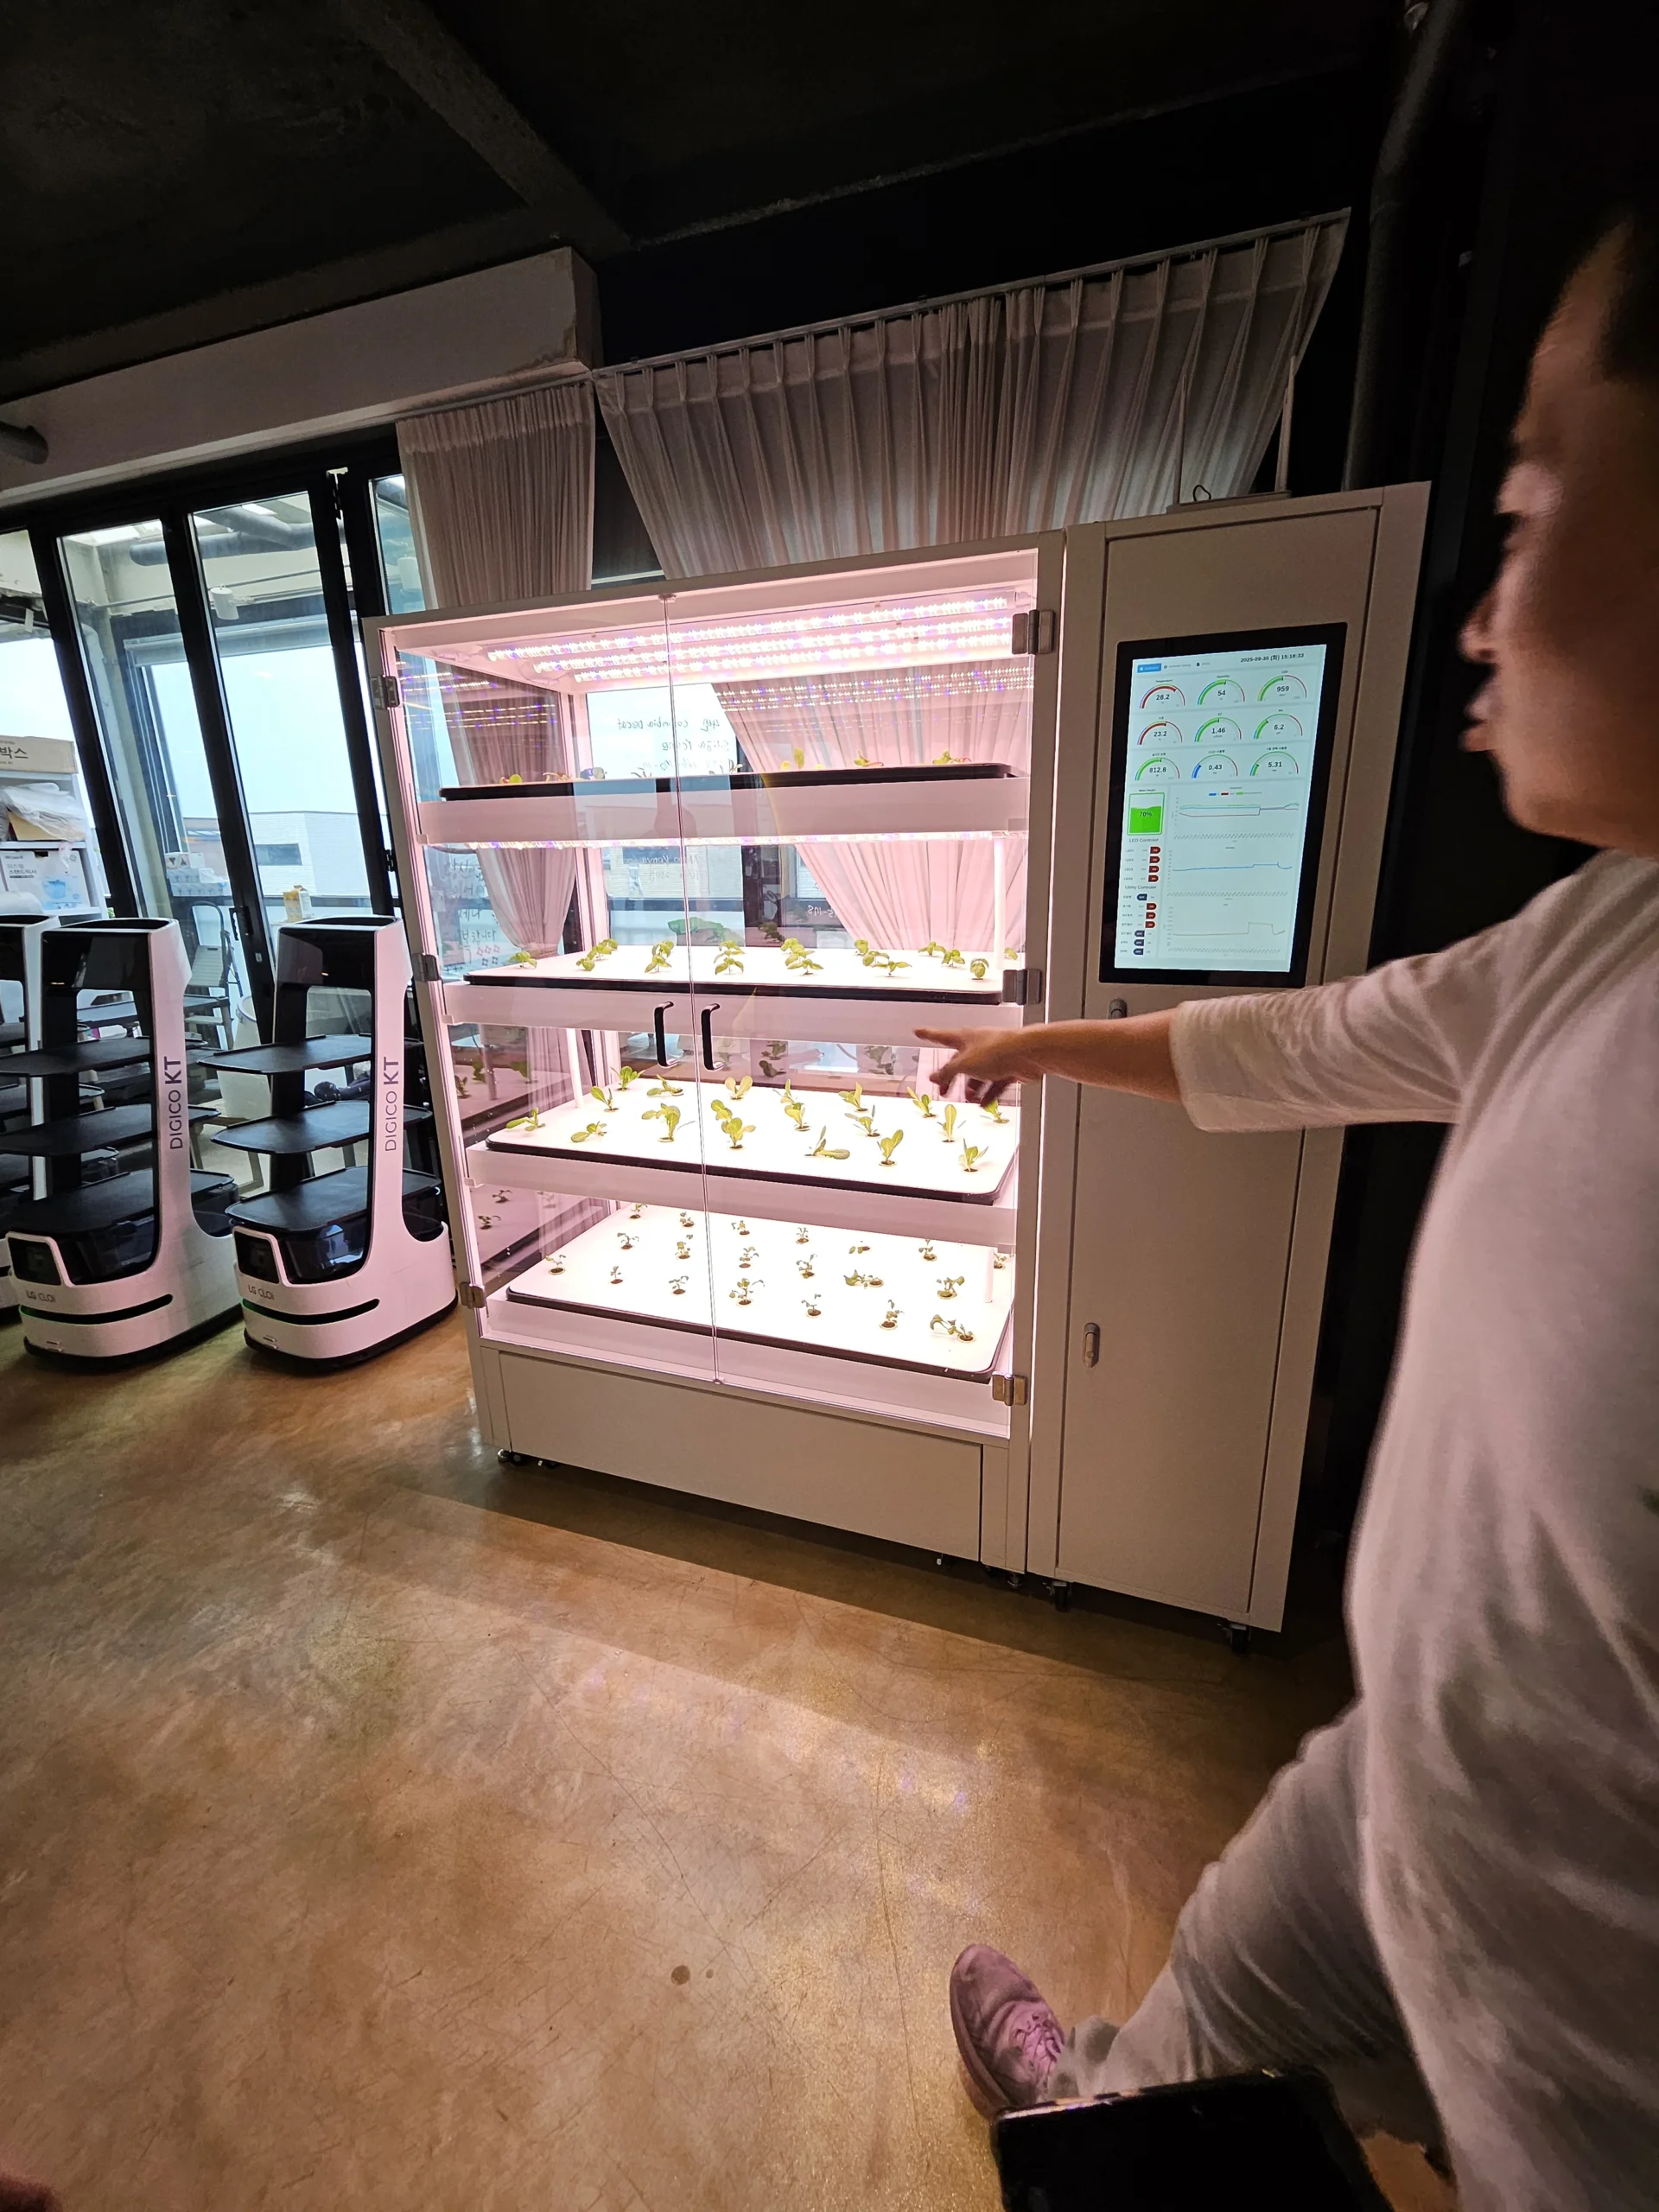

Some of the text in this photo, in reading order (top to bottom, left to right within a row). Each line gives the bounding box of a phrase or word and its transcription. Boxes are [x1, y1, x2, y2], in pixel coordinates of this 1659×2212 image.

[164, 1056, 184, 1150] DIGICO KT
[383, 1056, 399, 1153] DIGICO KT
[25, 1290, 36, 1300] LG
[247, 1284, 257, 1294] LG
